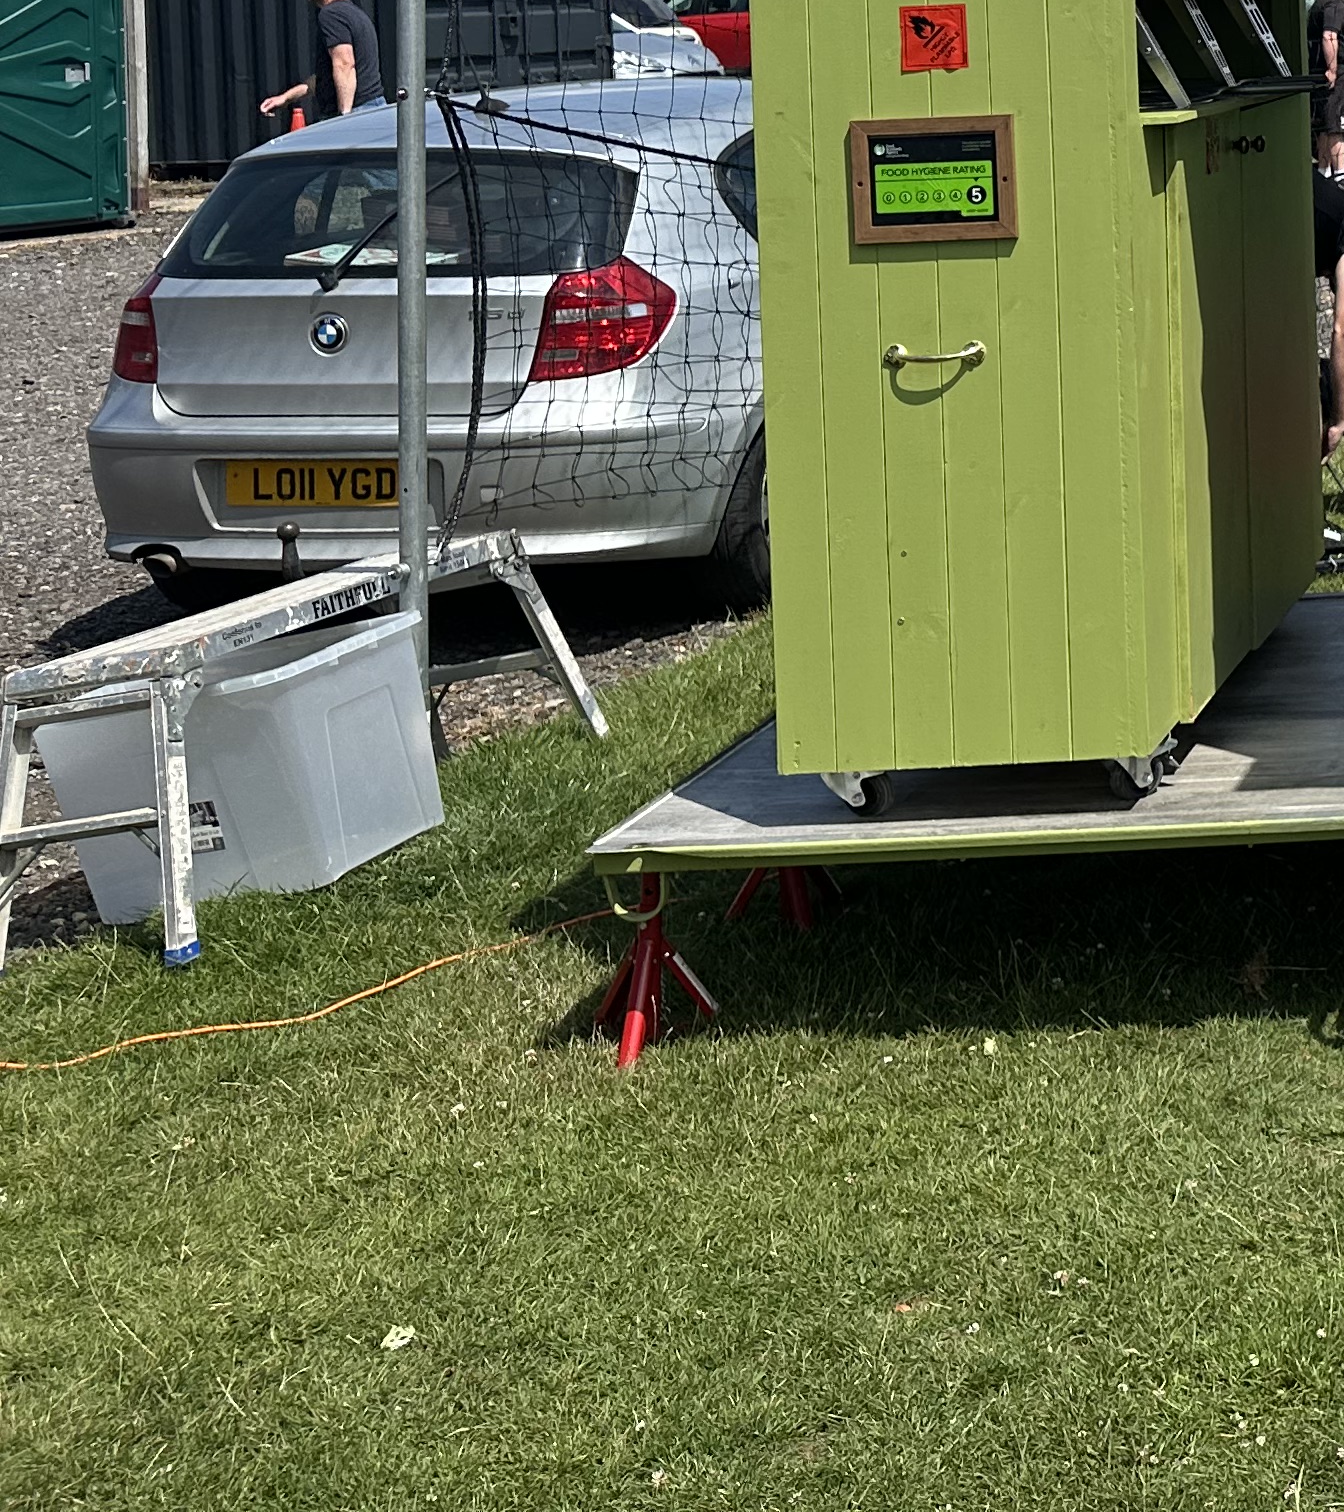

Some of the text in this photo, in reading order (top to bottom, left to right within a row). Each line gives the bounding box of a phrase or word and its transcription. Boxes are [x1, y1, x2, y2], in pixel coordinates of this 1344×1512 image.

[881, 164, 986, 177] FOOD HYGIENE RATING
[971, 187, 982, 202] 5
[252, 467, 397, 501] LO11 YGD
